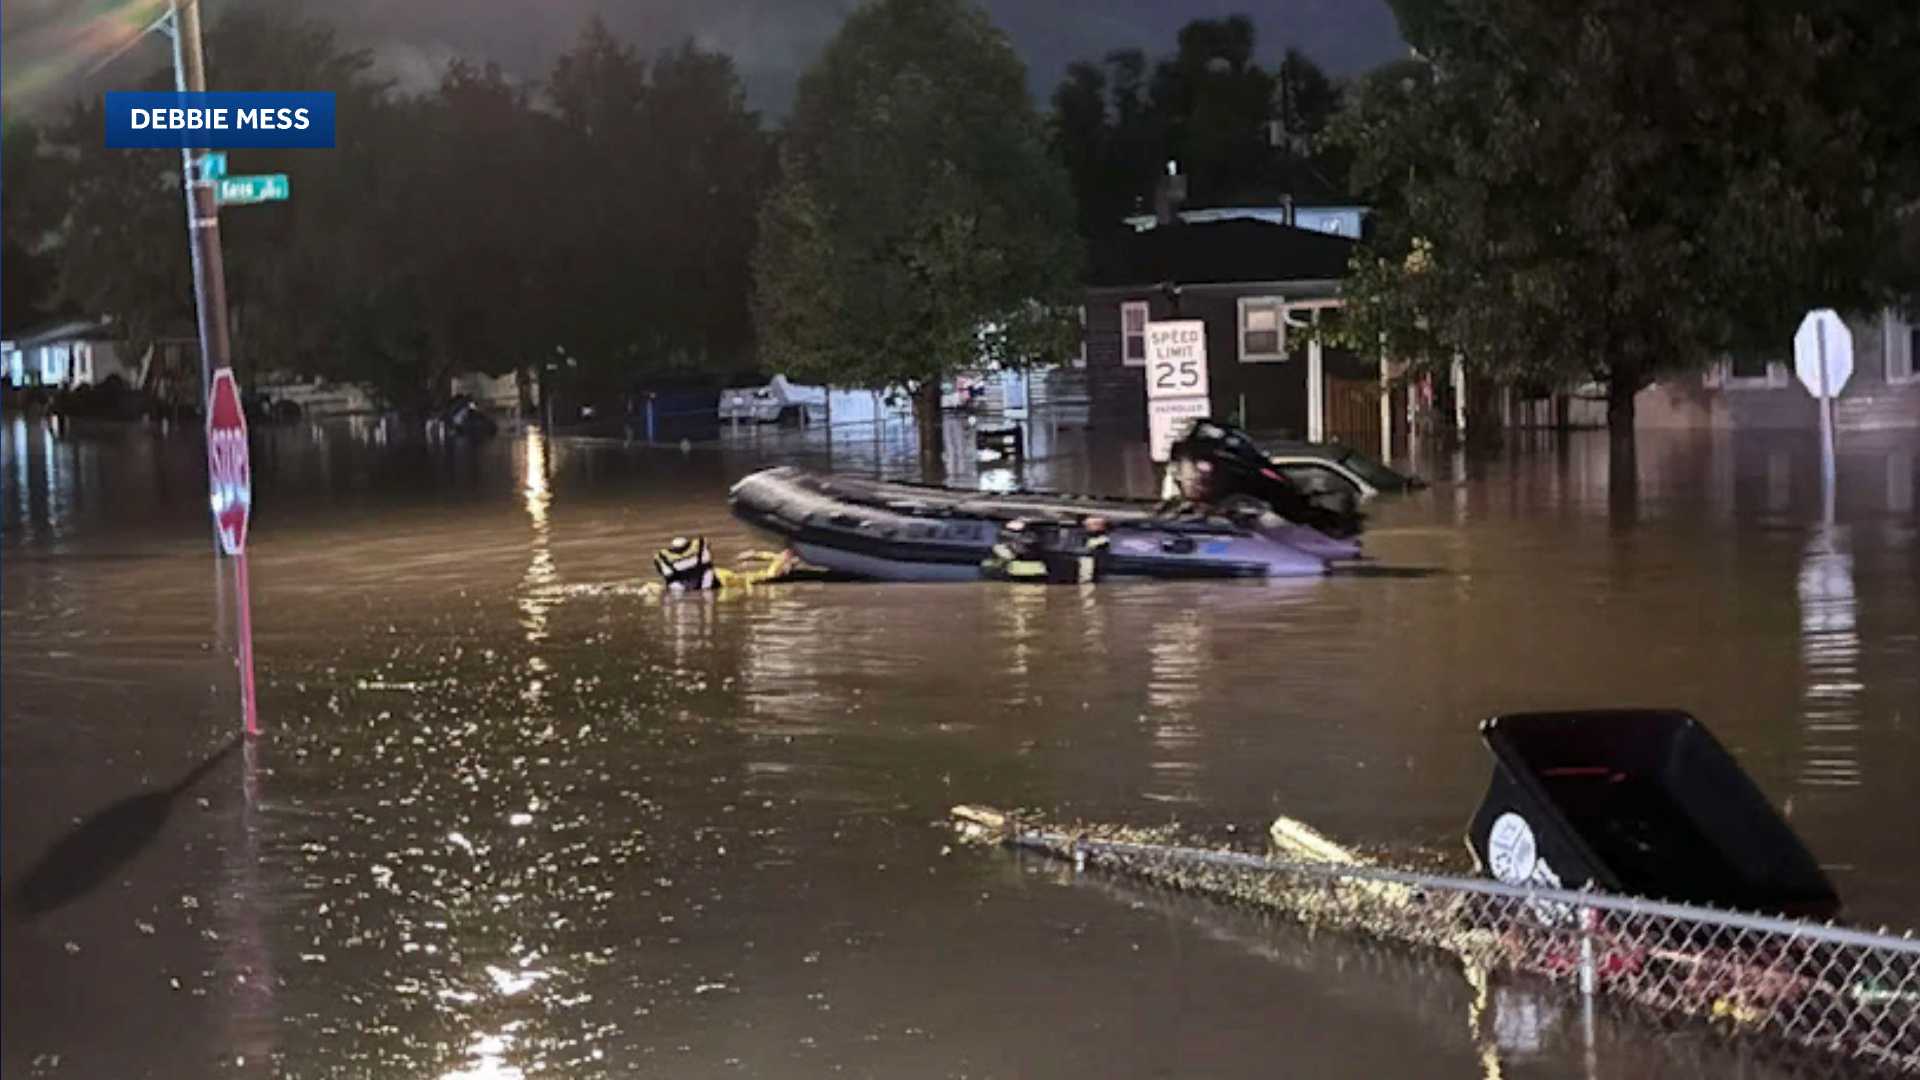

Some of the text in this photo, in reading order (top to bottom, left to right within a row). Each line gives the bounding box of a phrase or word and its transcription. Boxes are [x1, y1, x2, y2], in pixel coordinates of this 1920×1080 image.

[1151, 330, 1199, 345] SPEED
[1156, 346, 1194, 359] LIMIT
[1155, 361, 1199, 389] 25
[211, 428, 247, 512] STOP
